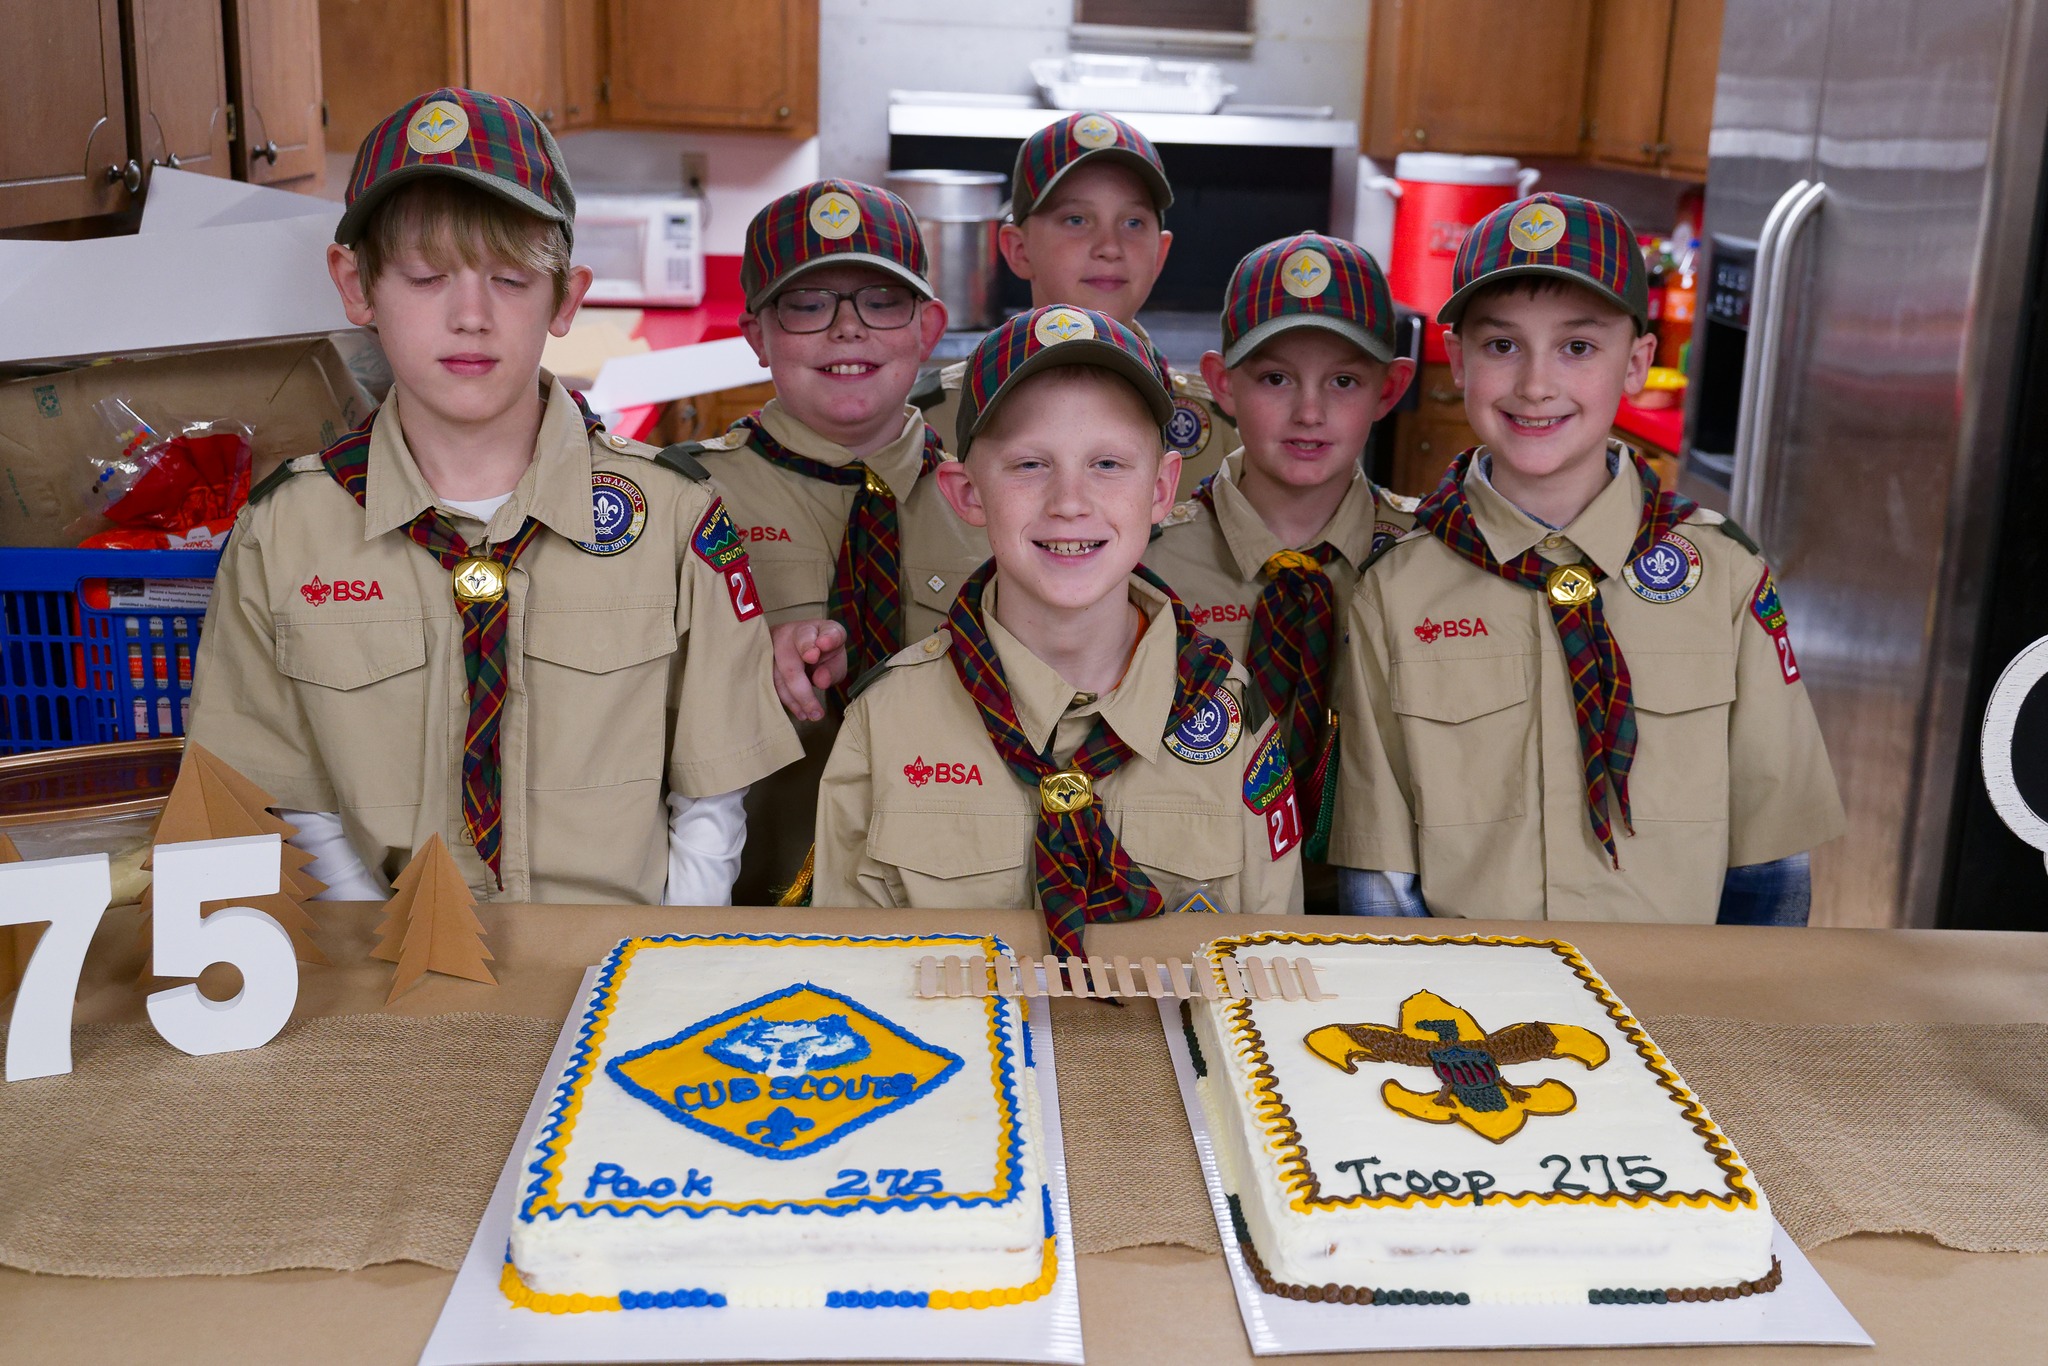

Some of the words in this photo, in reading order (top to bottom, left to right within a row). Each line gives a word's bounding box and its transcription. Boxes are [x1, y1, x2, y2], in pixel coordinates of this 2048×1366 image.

[611, 478, 642, 507] AMERICA
[583, 541, 610, 552] SINCE
[610, 538, 628, 551] 1910
[750, 526, 792, 542] BSA
[1666, 534, 1697, 561] AMERICA
[333, 580, 384, 602] BSA
[1641, 588, 1667, 601] SINCE
[1667, 588, 1684, 600] 1910
[1211, 603, 1251, 623] BSA
[1443, 617, 1489, 638] BSA
[1214, 688, 1238, 717] MERICA
[1179, 747, 1203, 761] SINCE
[1204, 747, 1222, 760] 1910
[1248, 741, 1272, 785] PALMETTO
[935, 762, 983, 786] BSA
[1261, 782, 1283, 807] SOUTH
[673, 1077, 761, 1111] CUB
[768, 1073, 917, 1101] SCOUTS
[825, 1168, 944, 1199] 275
[1335, 1155, 1496, 1206] Troop
[1539, 1154, 1668, 1192] 275
